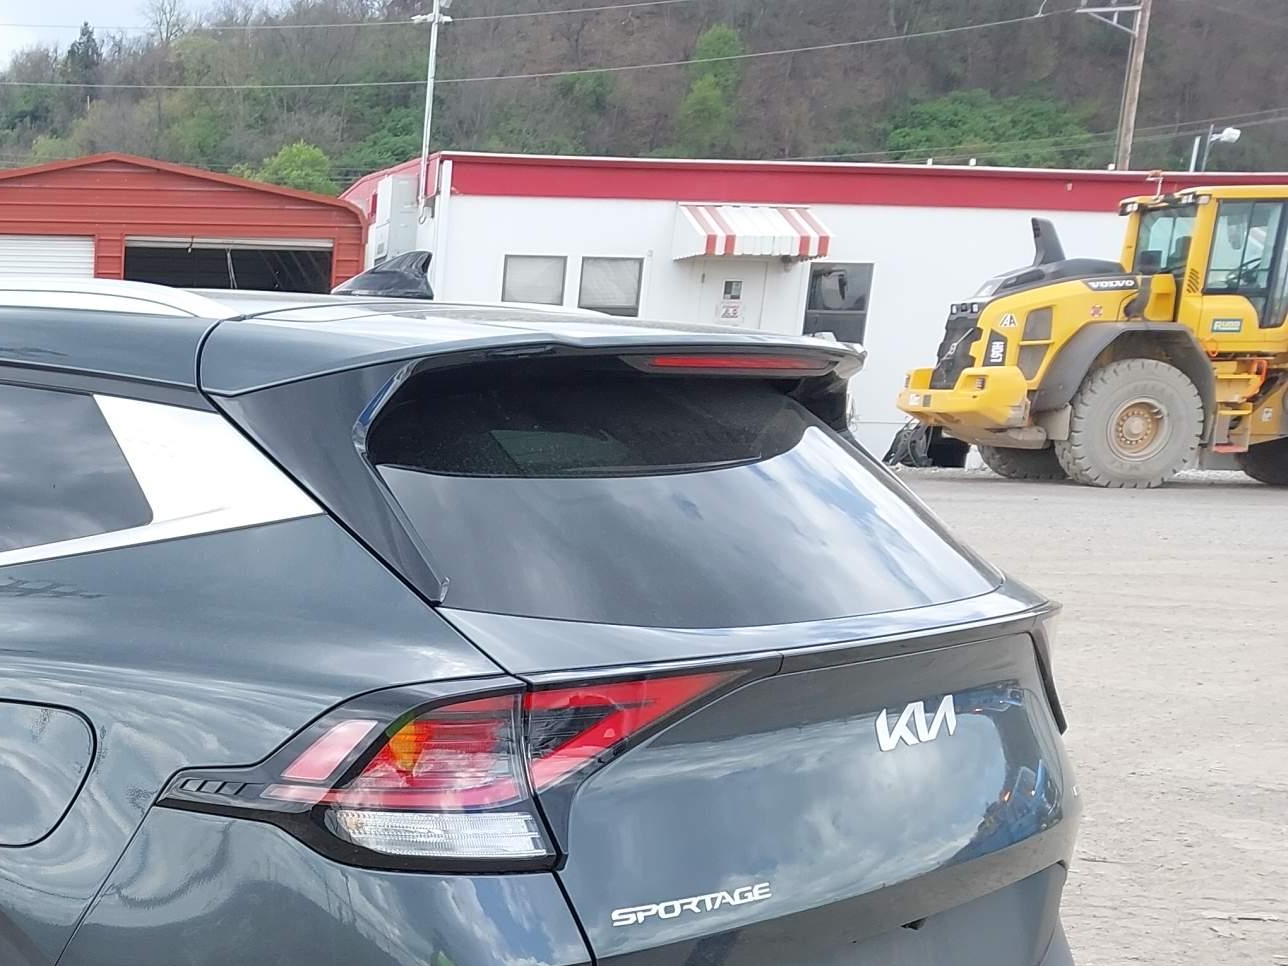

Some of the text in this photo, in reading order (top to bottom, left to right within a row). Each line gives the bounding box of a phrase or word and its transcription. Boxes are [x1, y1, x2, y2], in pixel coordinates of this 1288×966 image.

[1087, 279, 1135, 289] VOLVO
[990, 341, 1005, 363] L90H
[611, 882, 772, 927] SPORTAGE
